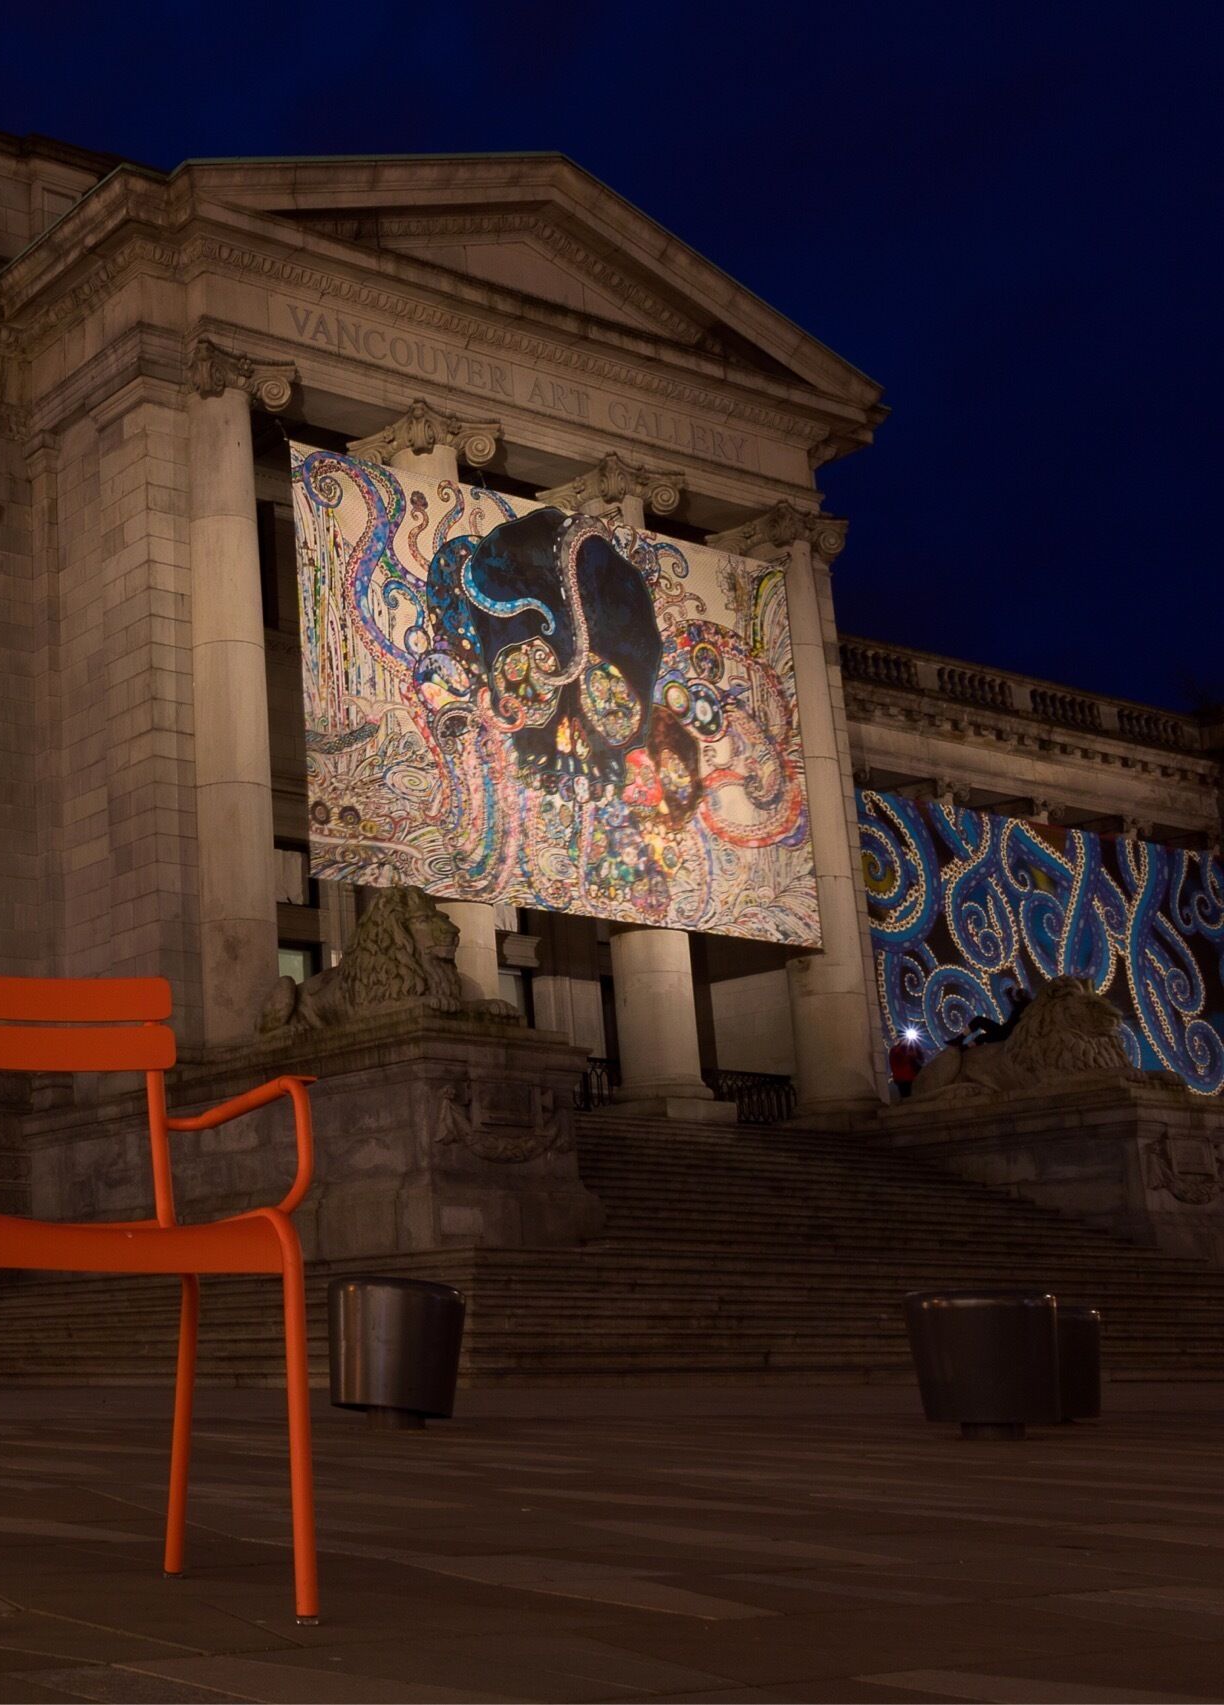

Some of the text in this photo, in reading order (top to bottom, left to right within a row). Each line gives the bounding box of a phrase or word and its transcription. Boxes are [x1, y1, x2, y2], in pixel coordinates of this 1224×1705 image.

[287, 304, 748, 464] VANCOUVER ART GALLERY
